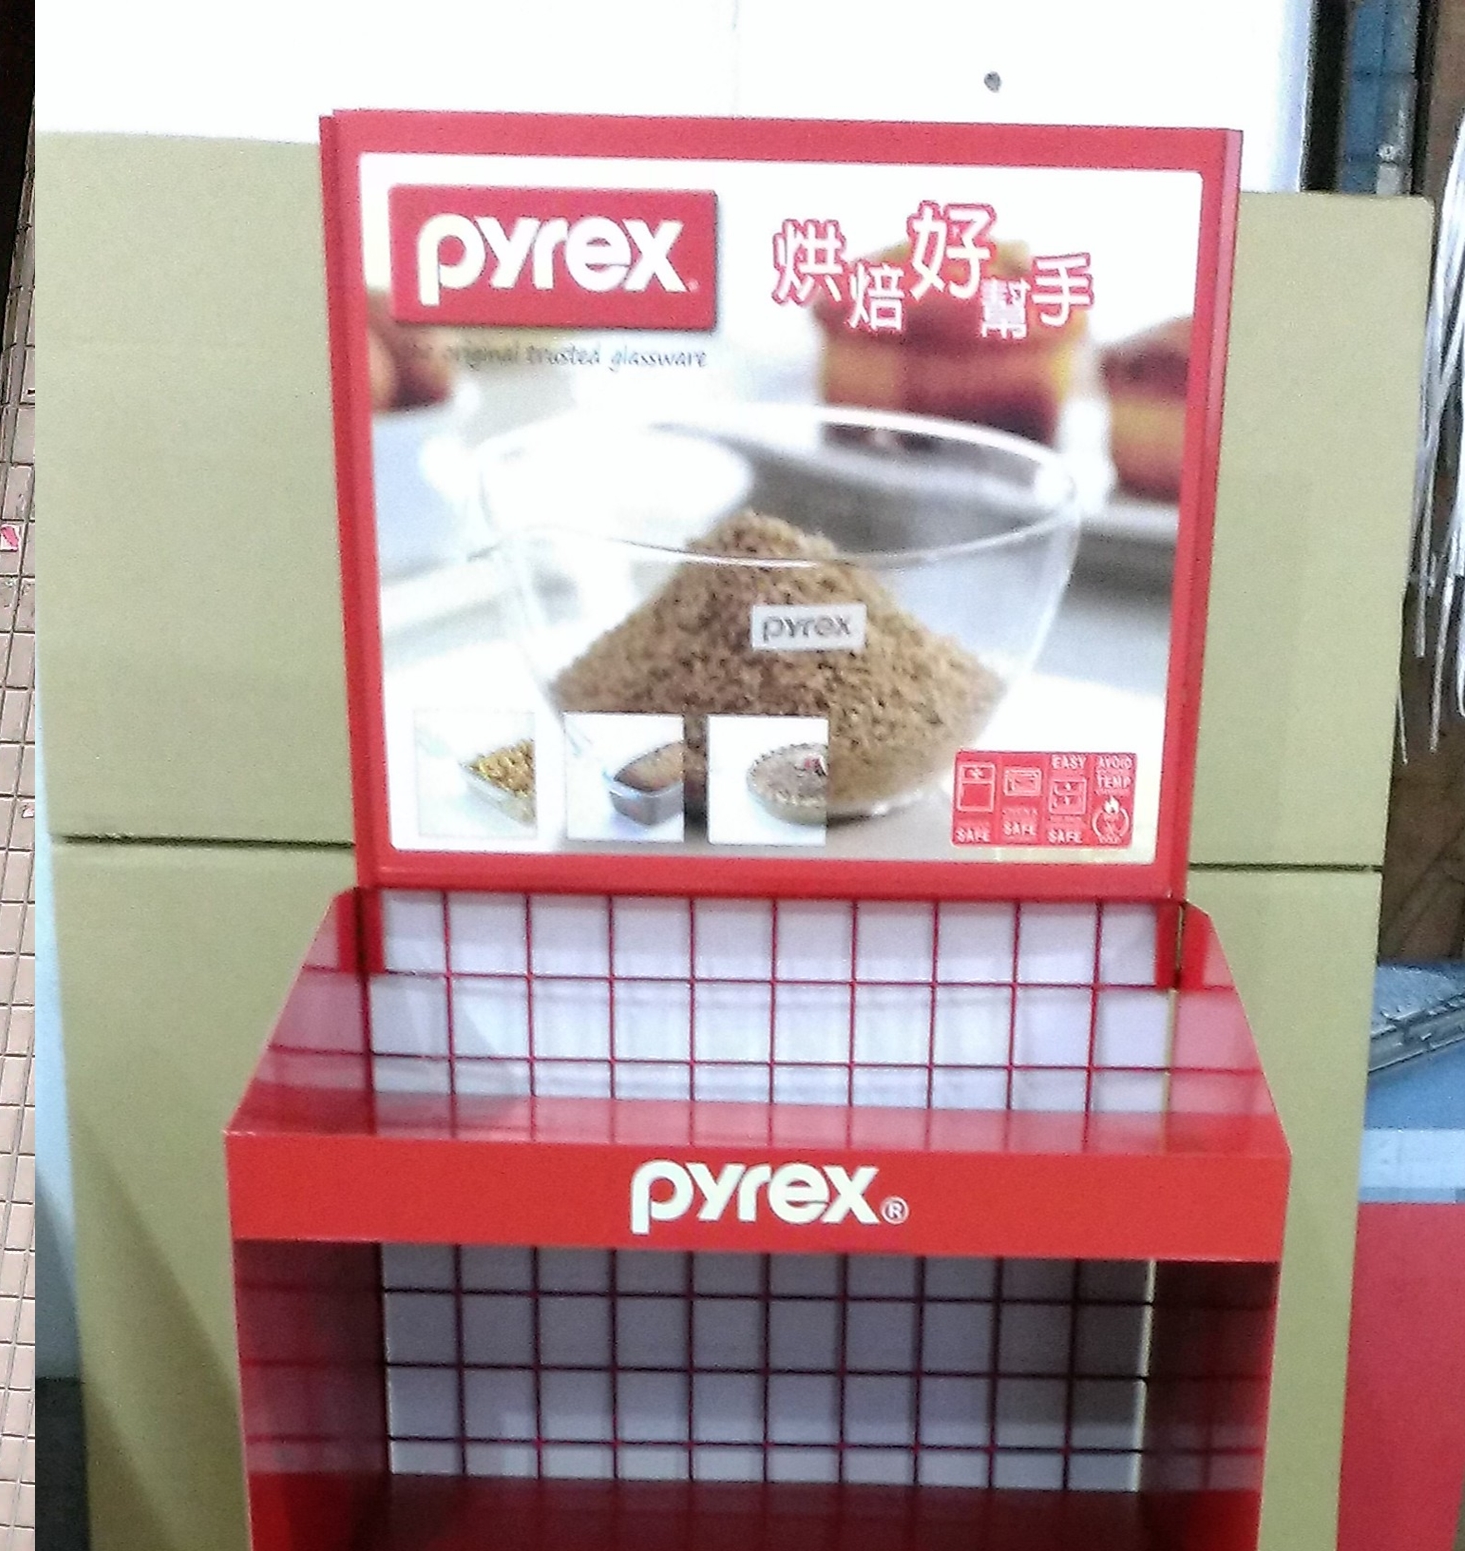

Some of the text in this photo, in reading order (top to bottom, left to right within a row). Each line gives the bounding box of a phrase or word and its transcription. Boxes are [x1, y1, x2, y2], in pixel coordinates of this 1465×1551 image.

[771, 199, 1095, 339] 烘焙好幫手
[762, 614, 851, 642] pyrex
